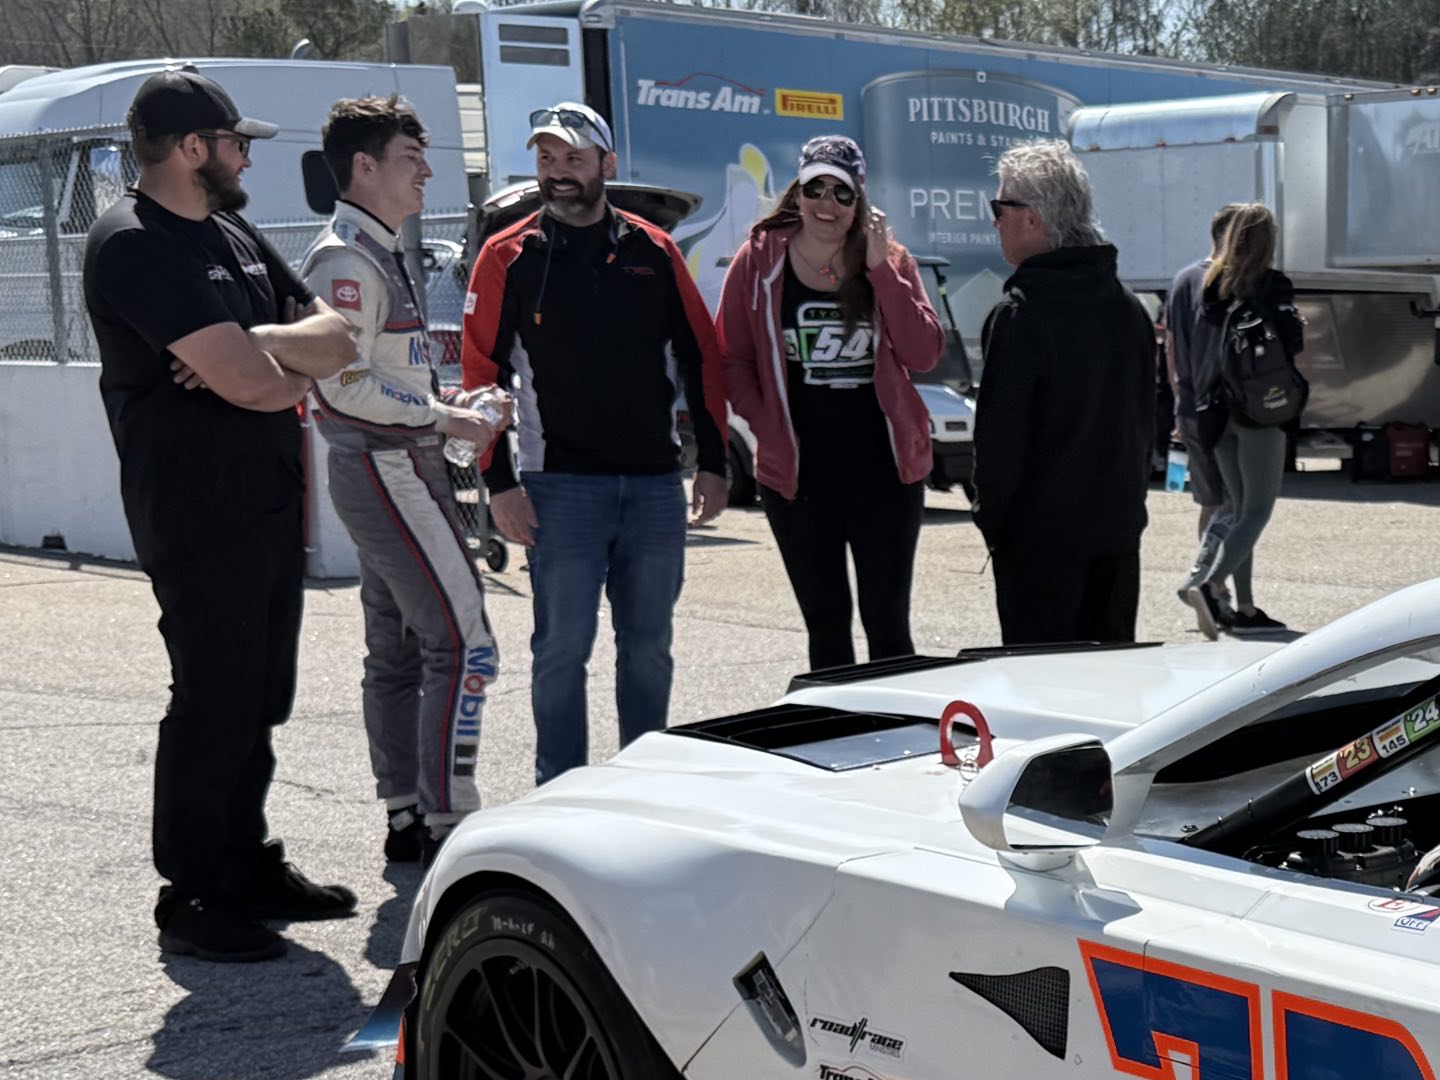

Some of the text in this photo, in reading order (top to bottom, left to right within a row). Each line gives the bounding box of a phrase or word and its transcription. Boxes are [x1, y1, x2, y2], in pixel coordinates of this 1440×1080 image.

[637, 79, 762, 115] Trans Am
[781, 94, 838, 116] PIRELLI
[908, 97, 1050, 133] PITTSBURGH
[931, 131, 974, 146] PAINTS
[977, 132, 987, 146] &
[811, 326, 875, 362] 54
[456, 646, 497, 737] Mobil
[1381, 734, 1407, 754] 145
